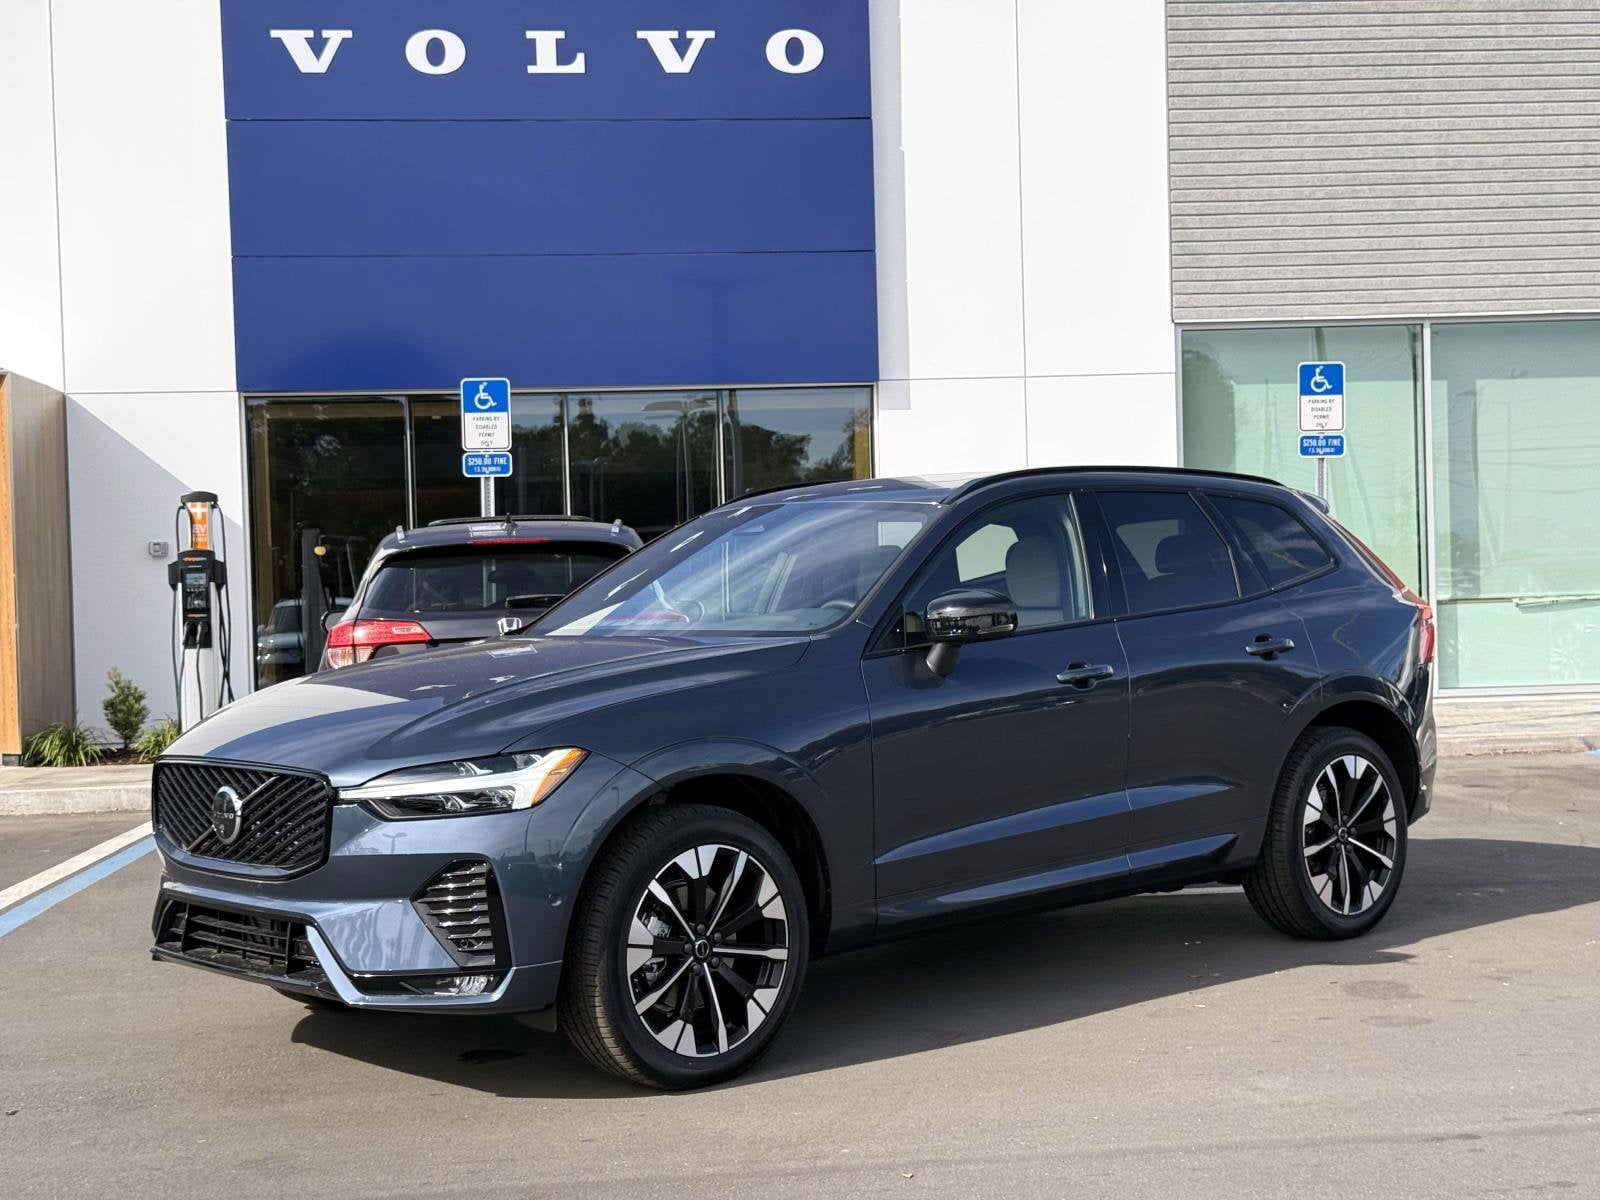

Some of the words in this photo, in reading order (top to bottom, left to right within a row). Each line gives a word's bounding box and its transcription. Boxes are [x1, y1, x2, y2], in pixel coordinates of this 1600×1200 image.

[269, 28, 825, 76] VOLVO
[1303, 438, 1326, 447] $250.00
[1328, 438, 1341, 447] FINE
[468, 457, 492, 466] $250.00
[493, 457, 508, 465] FINE
